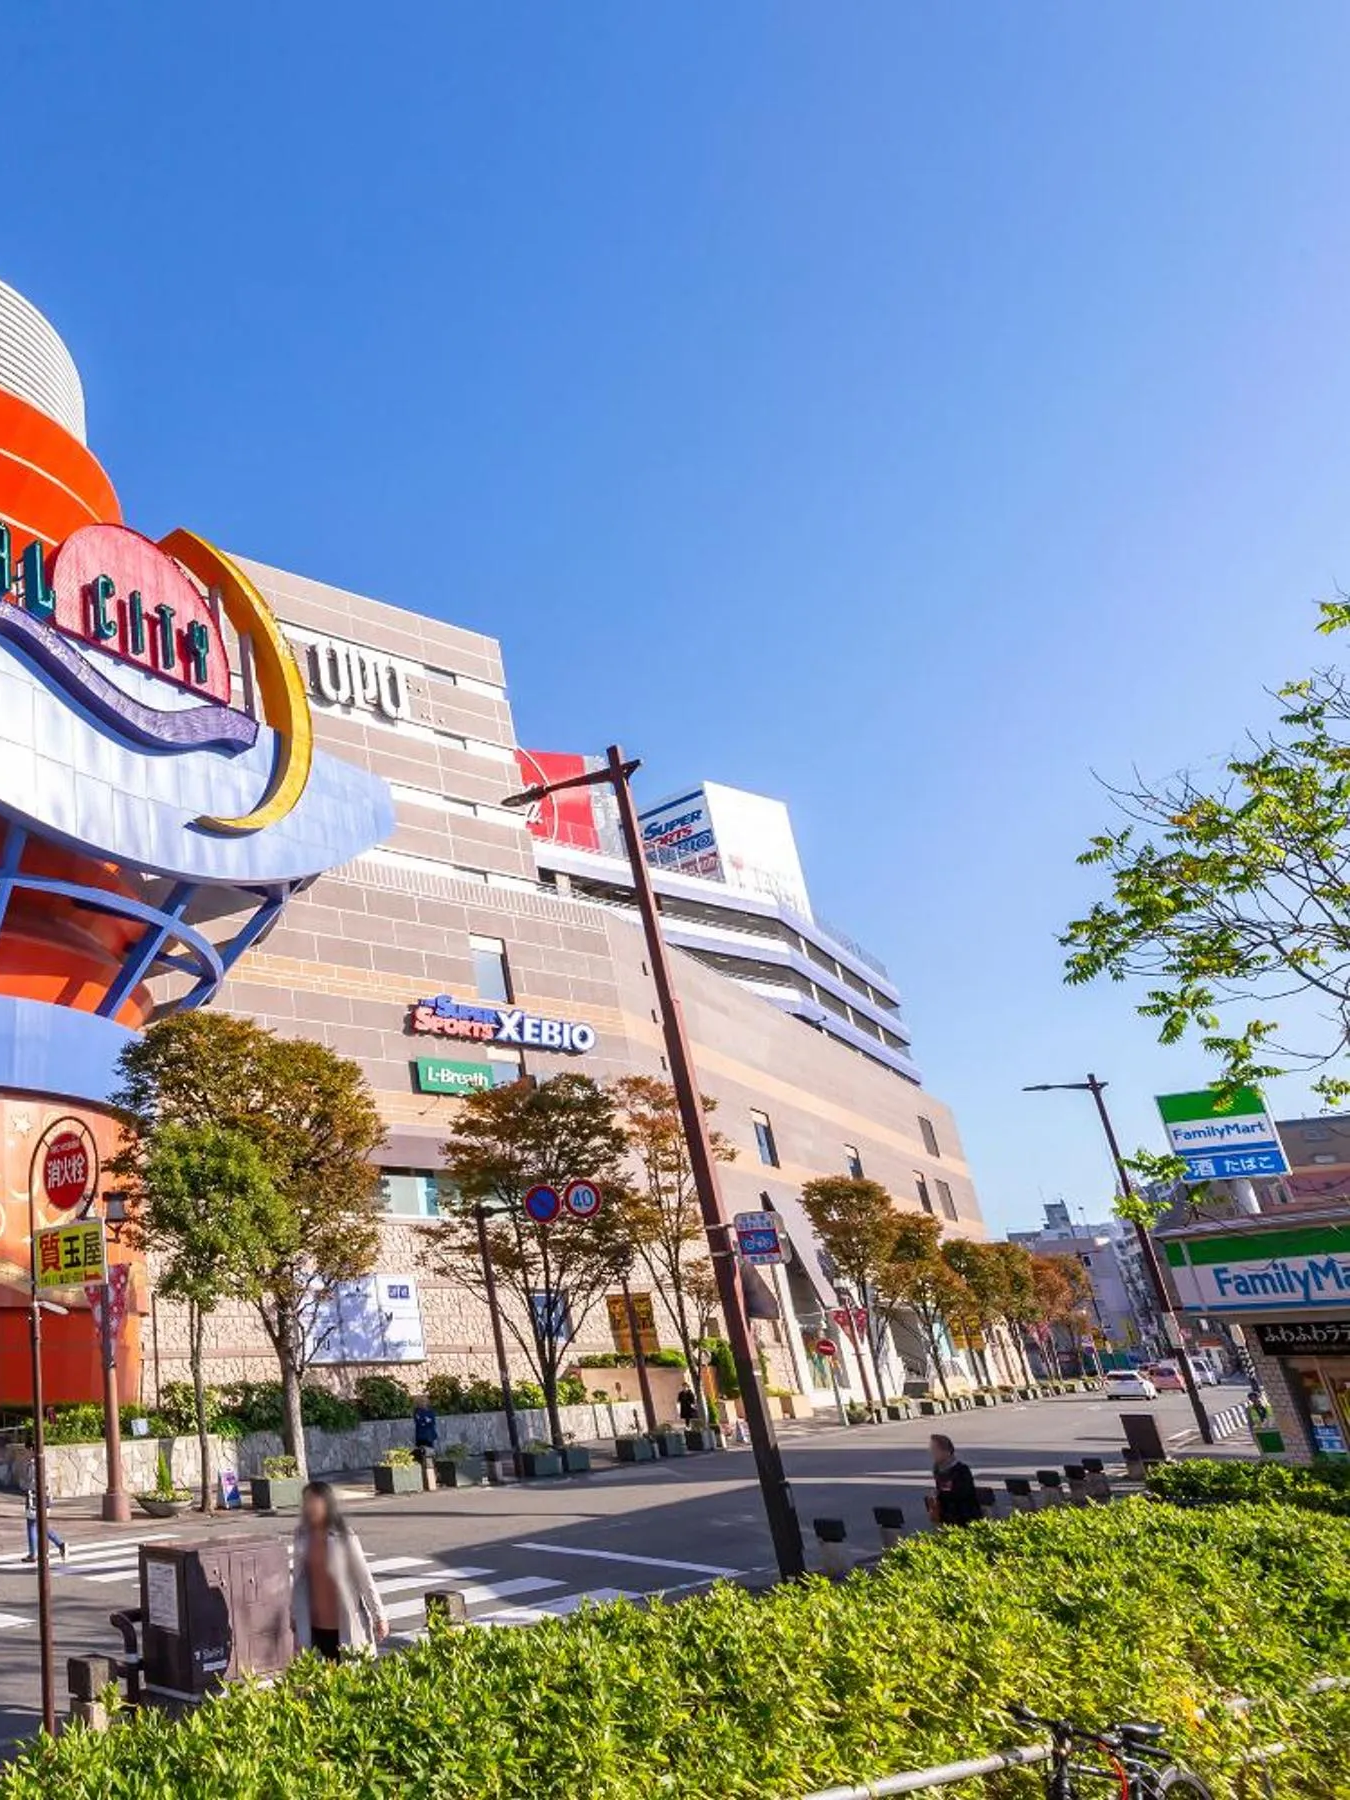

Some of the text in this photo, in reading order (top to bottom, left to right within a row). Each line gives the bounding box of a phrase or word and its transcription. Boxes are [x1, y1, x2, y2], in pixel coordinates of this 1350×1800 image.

[90, 573, 210, 685] CITY
[643, 809, 703, 841] SUPER
[414, 1006, 496, 1040] SPORTS
[435, 994, 499, 1025] SUPER
[495, 1009, 596, 1051] XEBIO
[427, 1066, 490, 1087] L-Breath
[1171, 1121, 1266, 1141] FamilyMart
[46, 1151, 86, 1190] 消火栓
[1190, 1156, 1275, 1177] 酒 たばこ
[572, 1188, 594, 1208] 40
